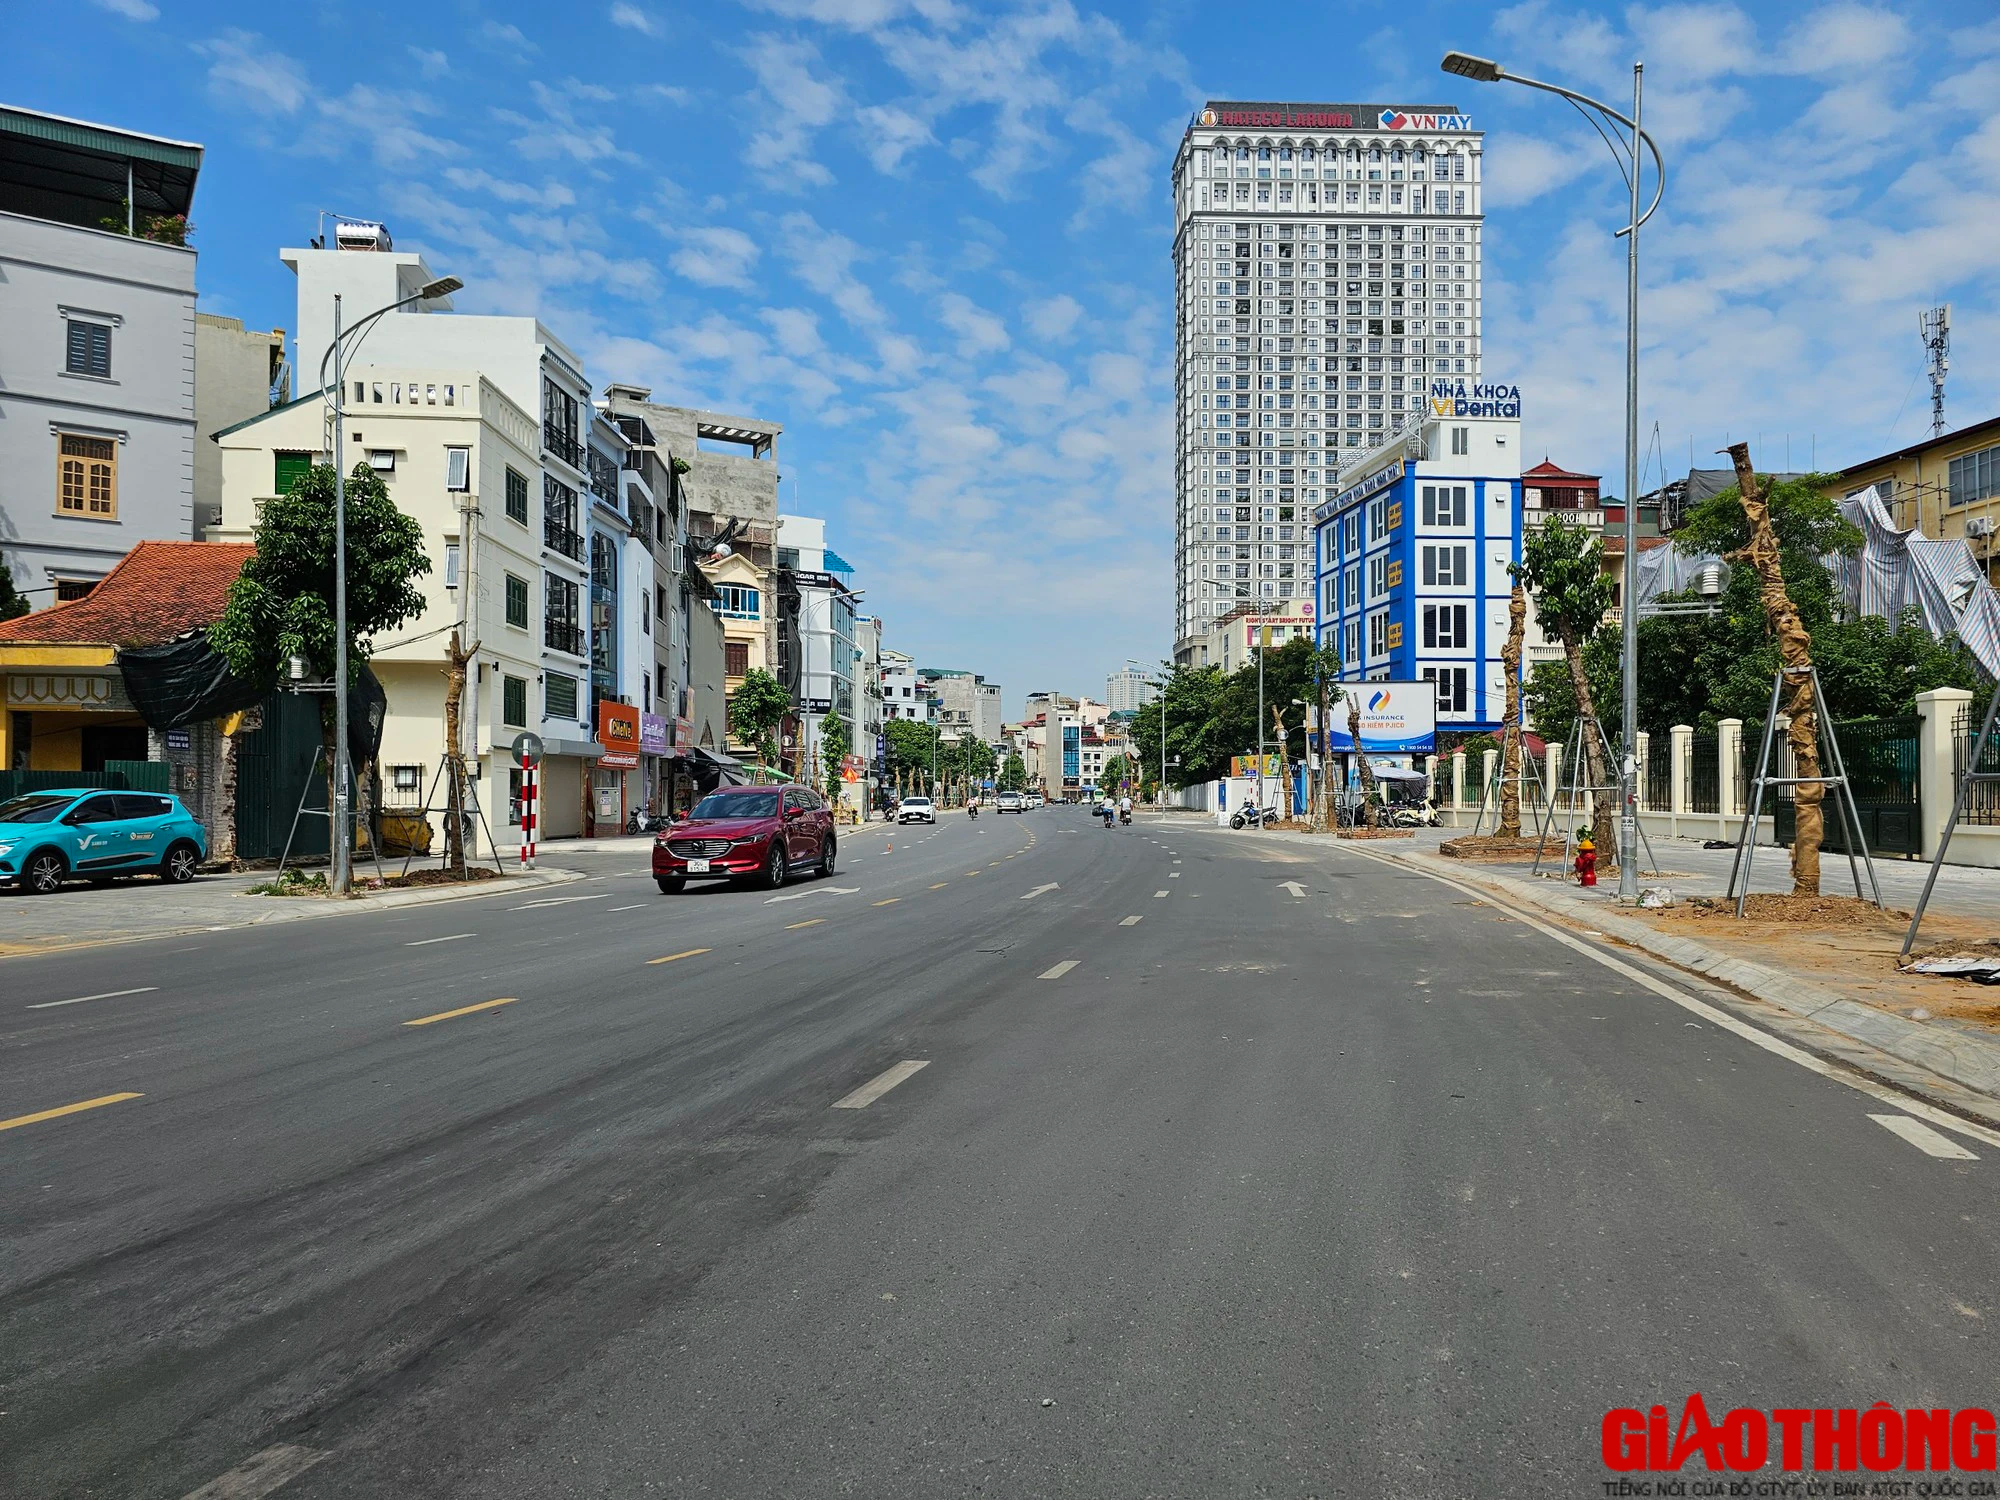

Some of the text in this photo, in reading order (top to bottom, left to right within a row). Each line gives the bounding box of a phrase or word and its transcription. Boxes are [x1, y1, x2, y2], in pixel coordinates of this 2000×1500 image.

[1222, 111, 1353, 128] HATECO LAROMA
[1411, 115, 1472, 130] VNPAY
[1431, 383, 1520, 399] NHA KHOA
